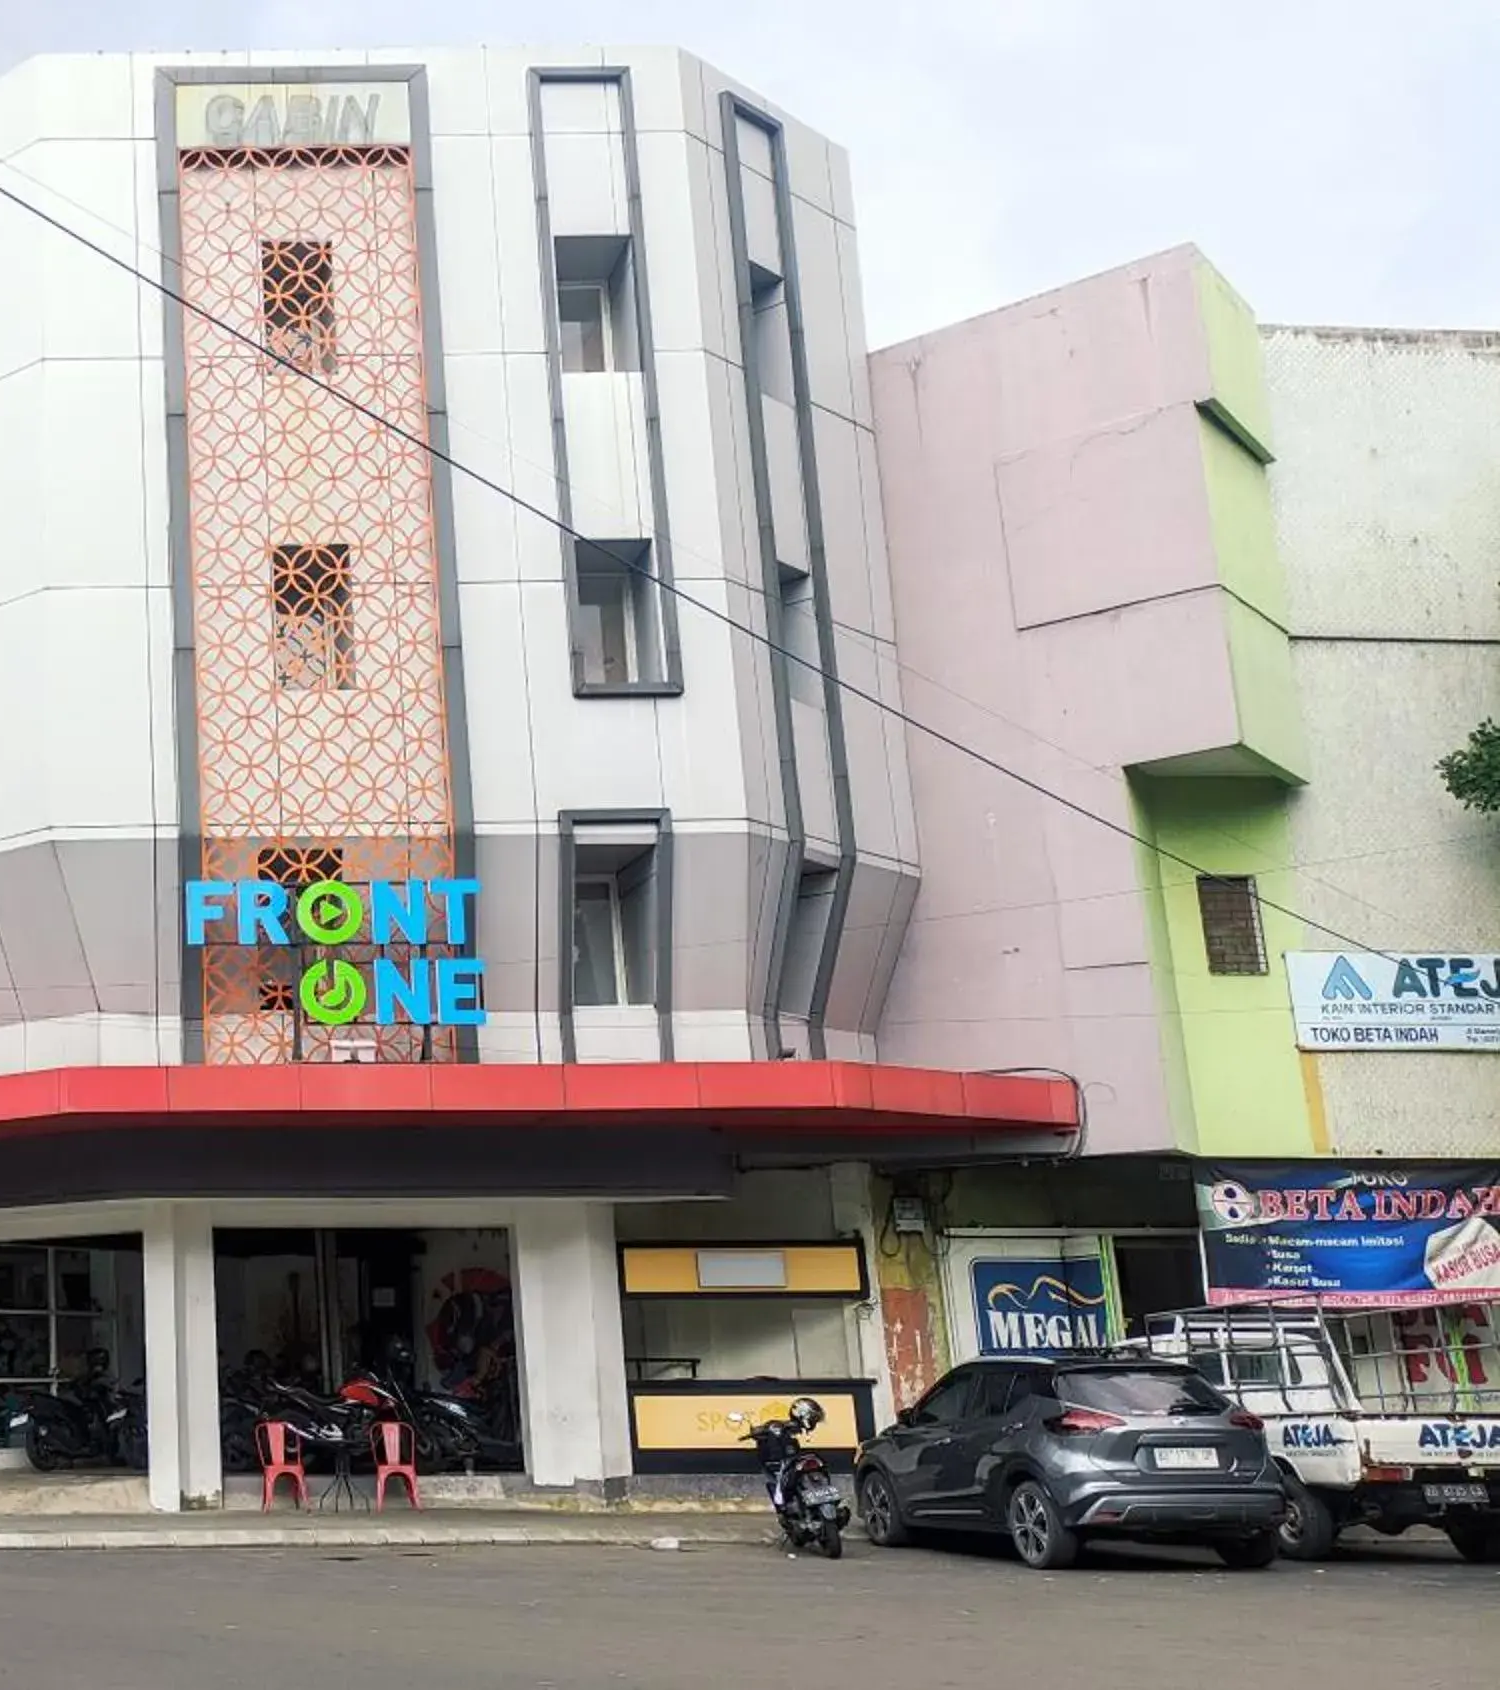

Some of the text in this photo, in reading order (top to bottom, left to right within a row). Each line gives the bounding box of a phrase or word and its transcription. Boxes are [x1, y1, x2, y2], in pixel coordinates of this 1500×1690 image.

[186, 879, 481, 945] FRONT
[299, 958, 486, 1025] ONE
[1393, 957, 1500, 997] ATEJ
[1321, 1003, 1500, 1015] KAIN INTERIOR STANDAR
[1311, 1027, 1439, 1043] TOKO BETA INDAH
[1257, 1186, 1500, 1221] BETA INDAH
[1283, 1423, 1336, 1447] ATEJA
